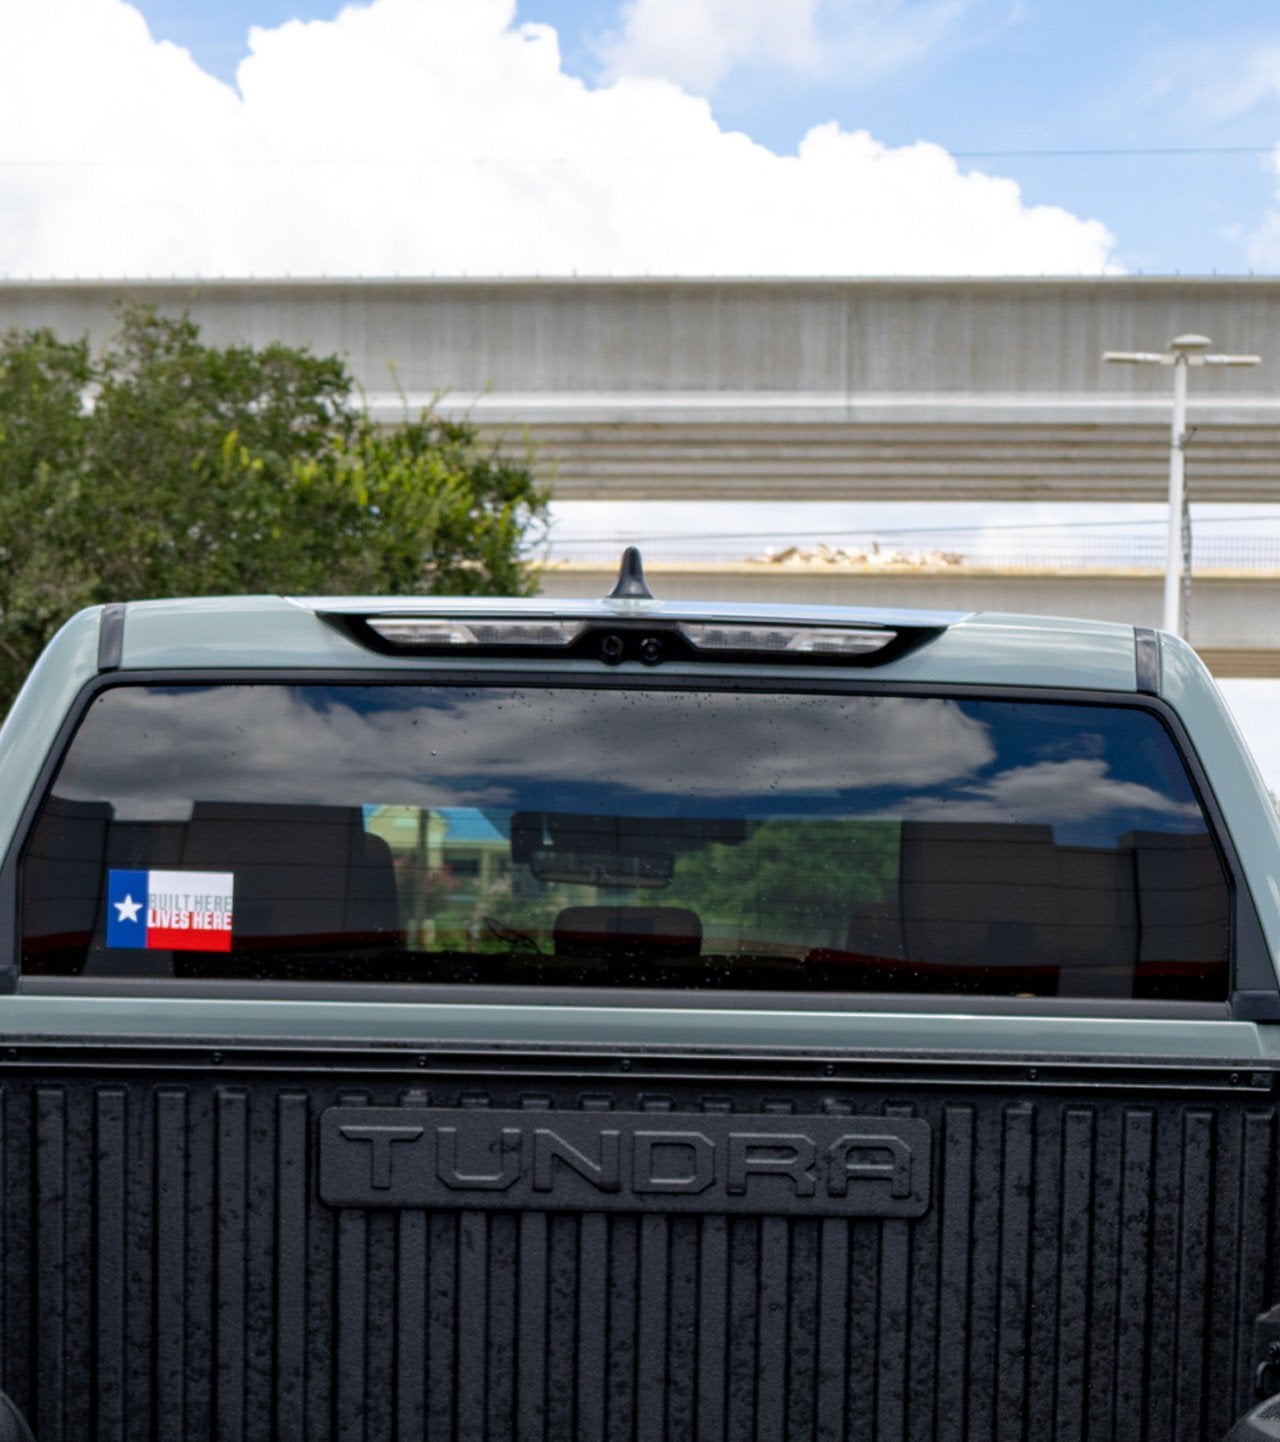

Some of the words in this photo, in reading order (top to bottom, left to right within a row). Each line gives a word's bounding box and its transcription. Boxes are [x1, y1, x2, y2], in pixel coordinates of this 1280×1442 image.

[148, 893, 191, 910] BUILT
[194, 895, 233, 912] HERE
[147, 910, 190, 928] LIVES
[193, 912, 232, 930] HERE
[339, 1126, 913, 1199] TUNDRA
